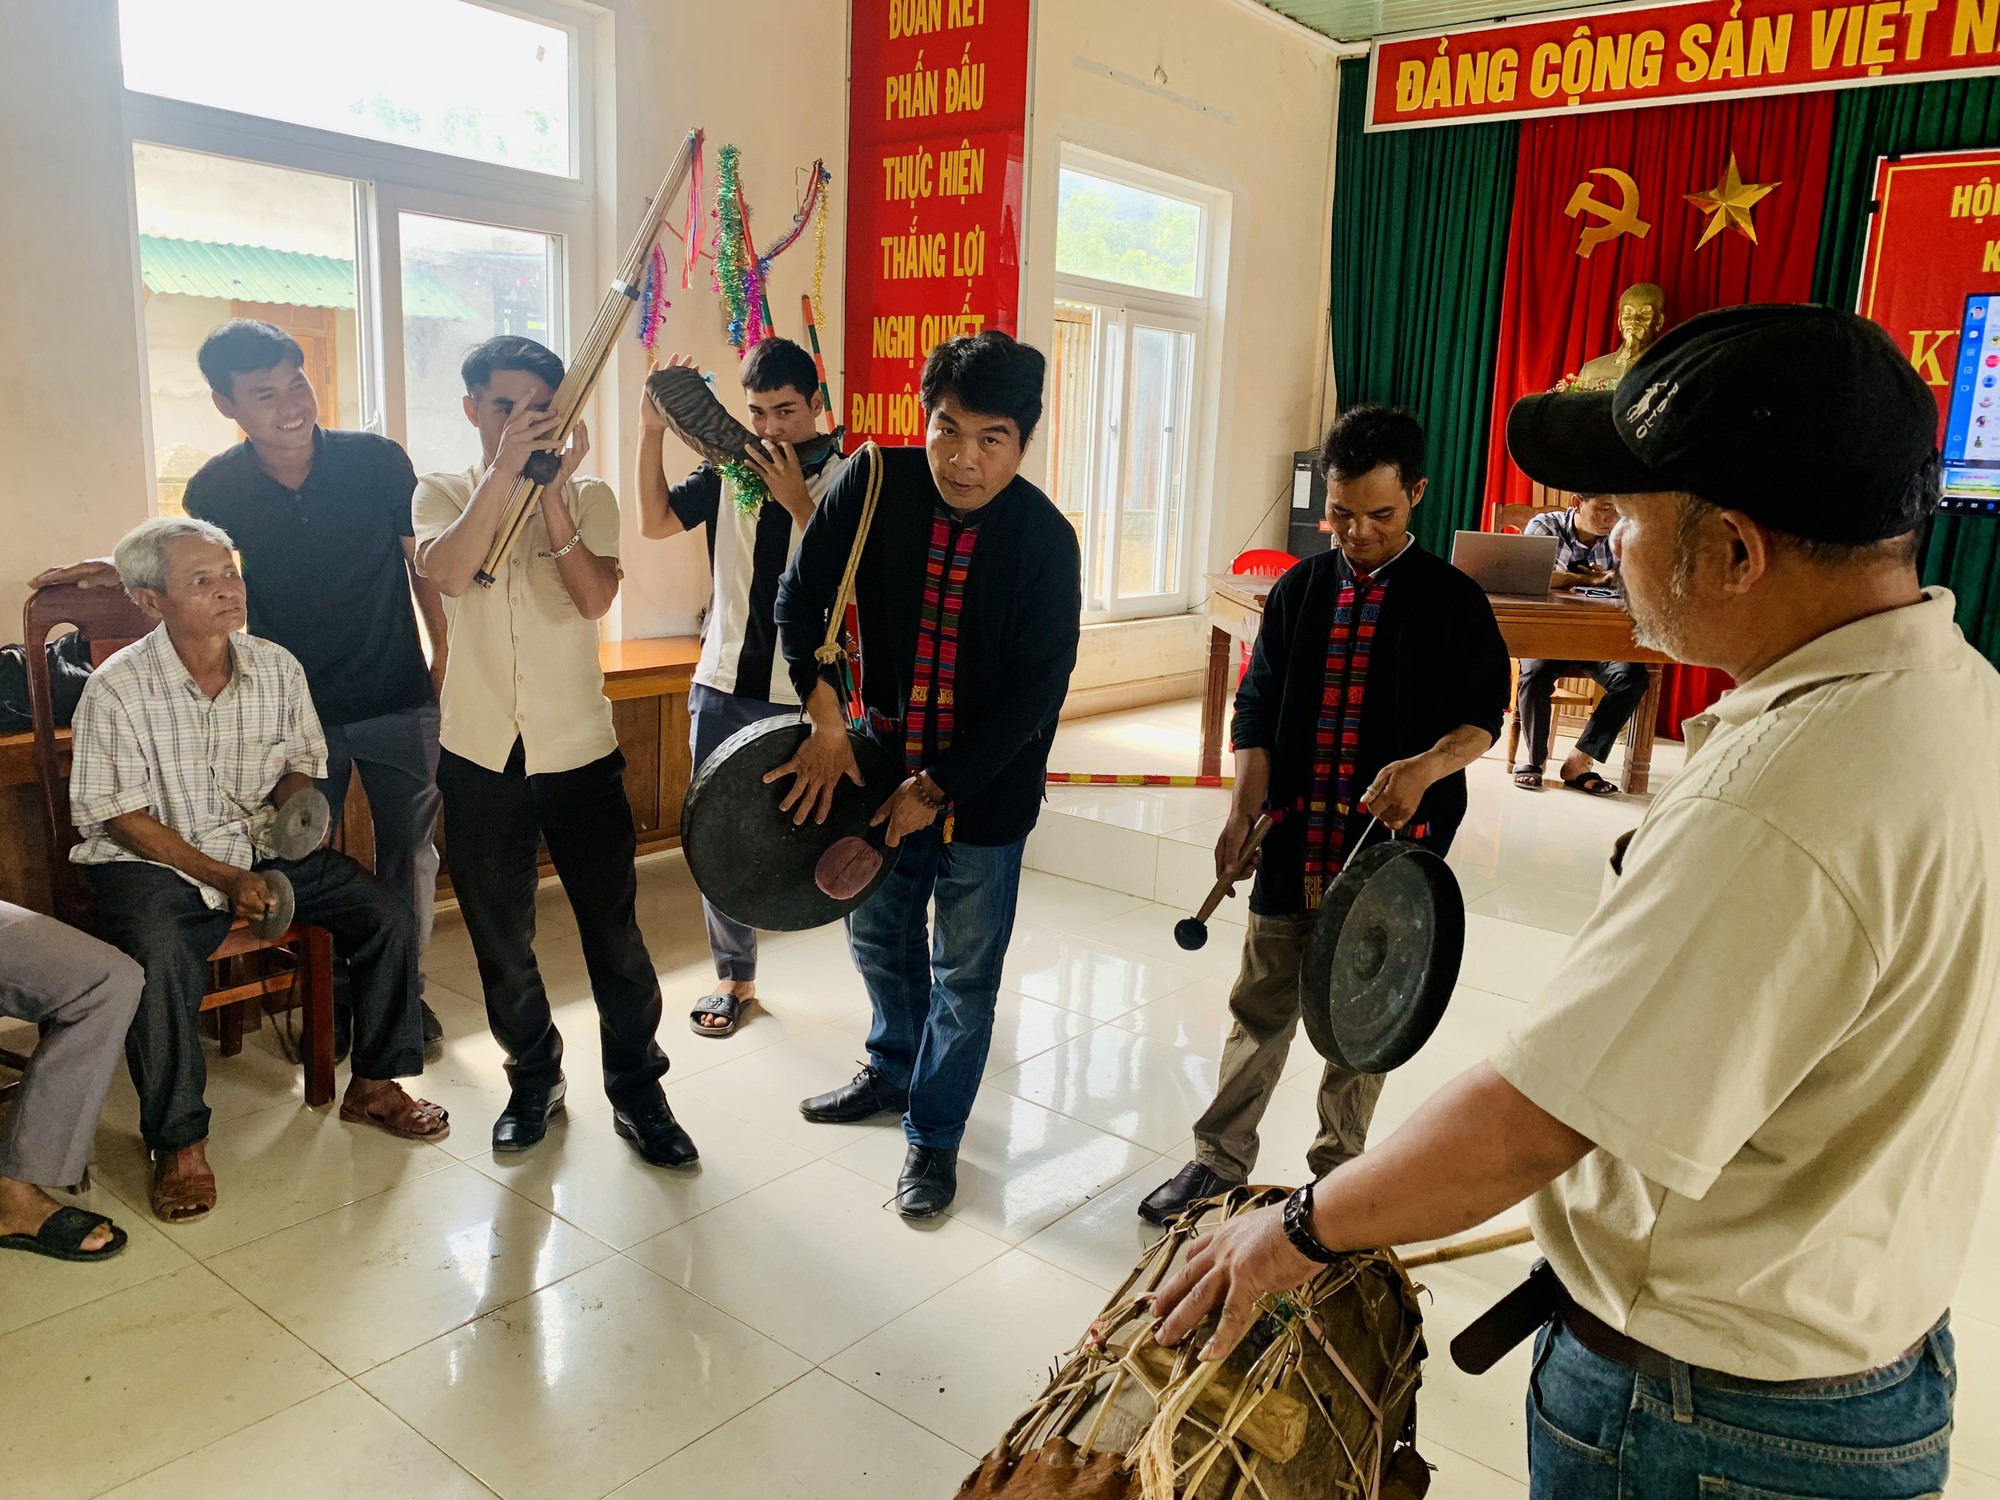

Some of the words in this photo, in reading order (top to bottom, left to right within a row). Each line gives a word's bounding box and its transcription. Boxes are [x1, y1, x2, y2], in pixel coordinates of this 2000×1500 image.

[885, 49, 939, 121] PHẤN
[945, 41, 985, 114] ĐẤU
[1396, 37, 1519, 112] ĐẢNG
[1529, 25, 1665, 106] CỘNG
[1676, 0, 1793, 83] SẢN
[1811, 0, 1939, 76] VIỆT
[1950, 0, 2000, 56] N
[883, 145, 933, 209] THỰC
[938, 138, 985, 205] HIỆN
[881, 215, 946, 280] THẮNG
[953, 224, 985, 287] LỢI
[872, 315, 915, 369] NGHỊ
[1908, 330, 1960, 386] K
[851, 393, 883, 441] ĐẠI
[888, 382, 919, 446] HỘI
